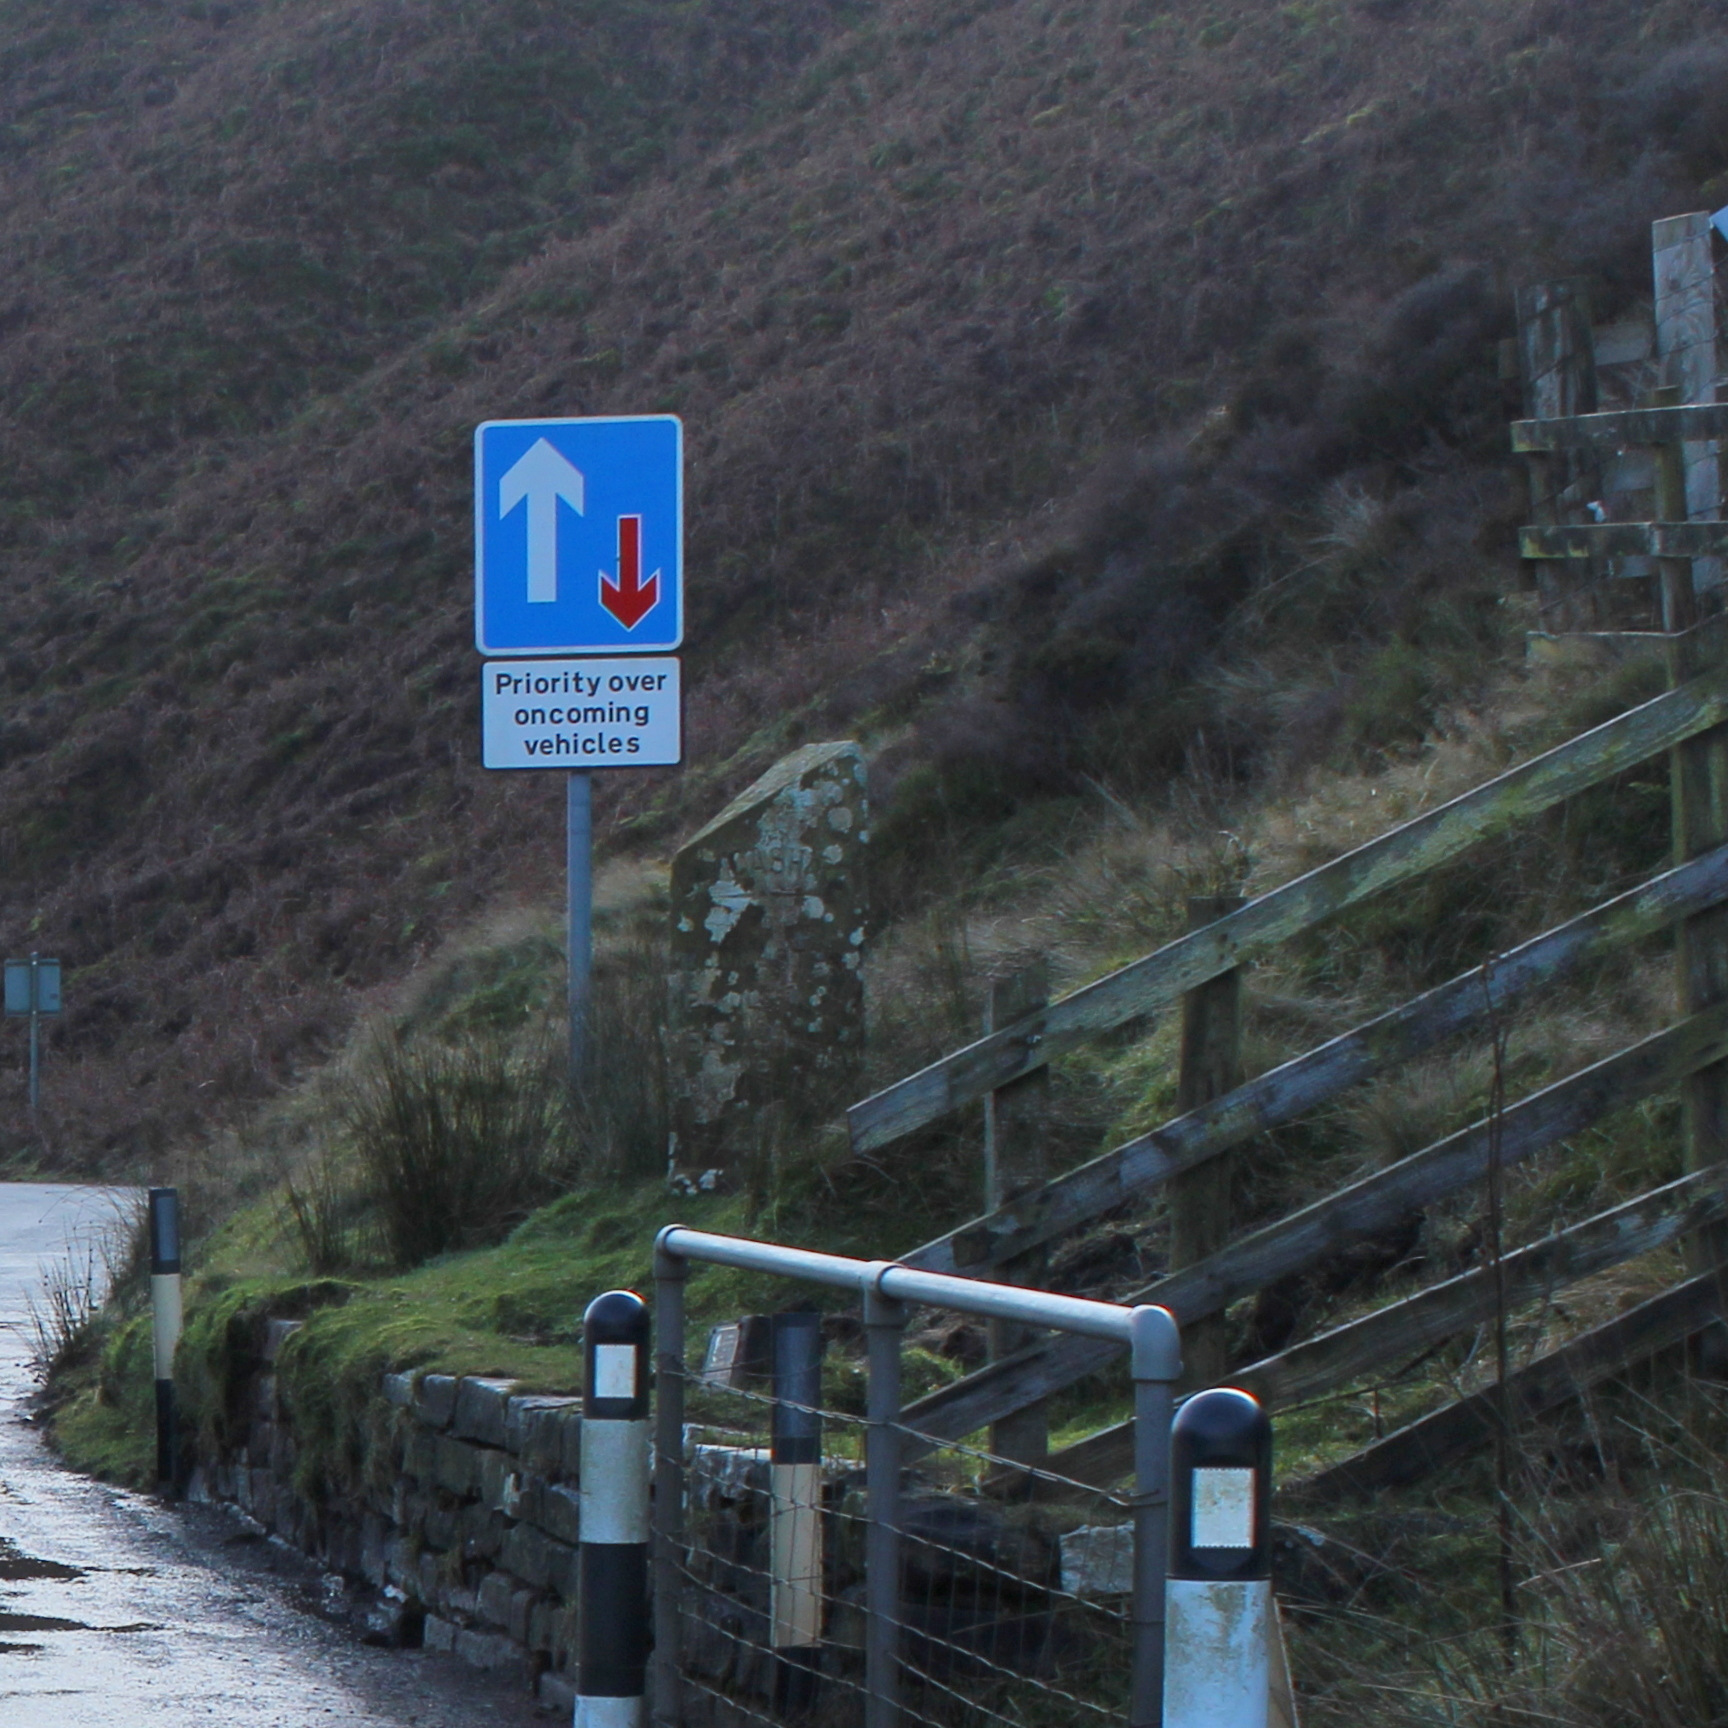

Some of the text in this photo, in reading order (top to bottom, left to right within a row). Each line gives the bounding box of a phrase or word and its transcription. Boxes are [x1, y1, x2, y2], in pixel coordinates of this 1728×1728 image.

[495, 671, 667, 697] Priority over
[514, 701, 650, 727] oncoming
[524, 732, 640, 755] vehicles
